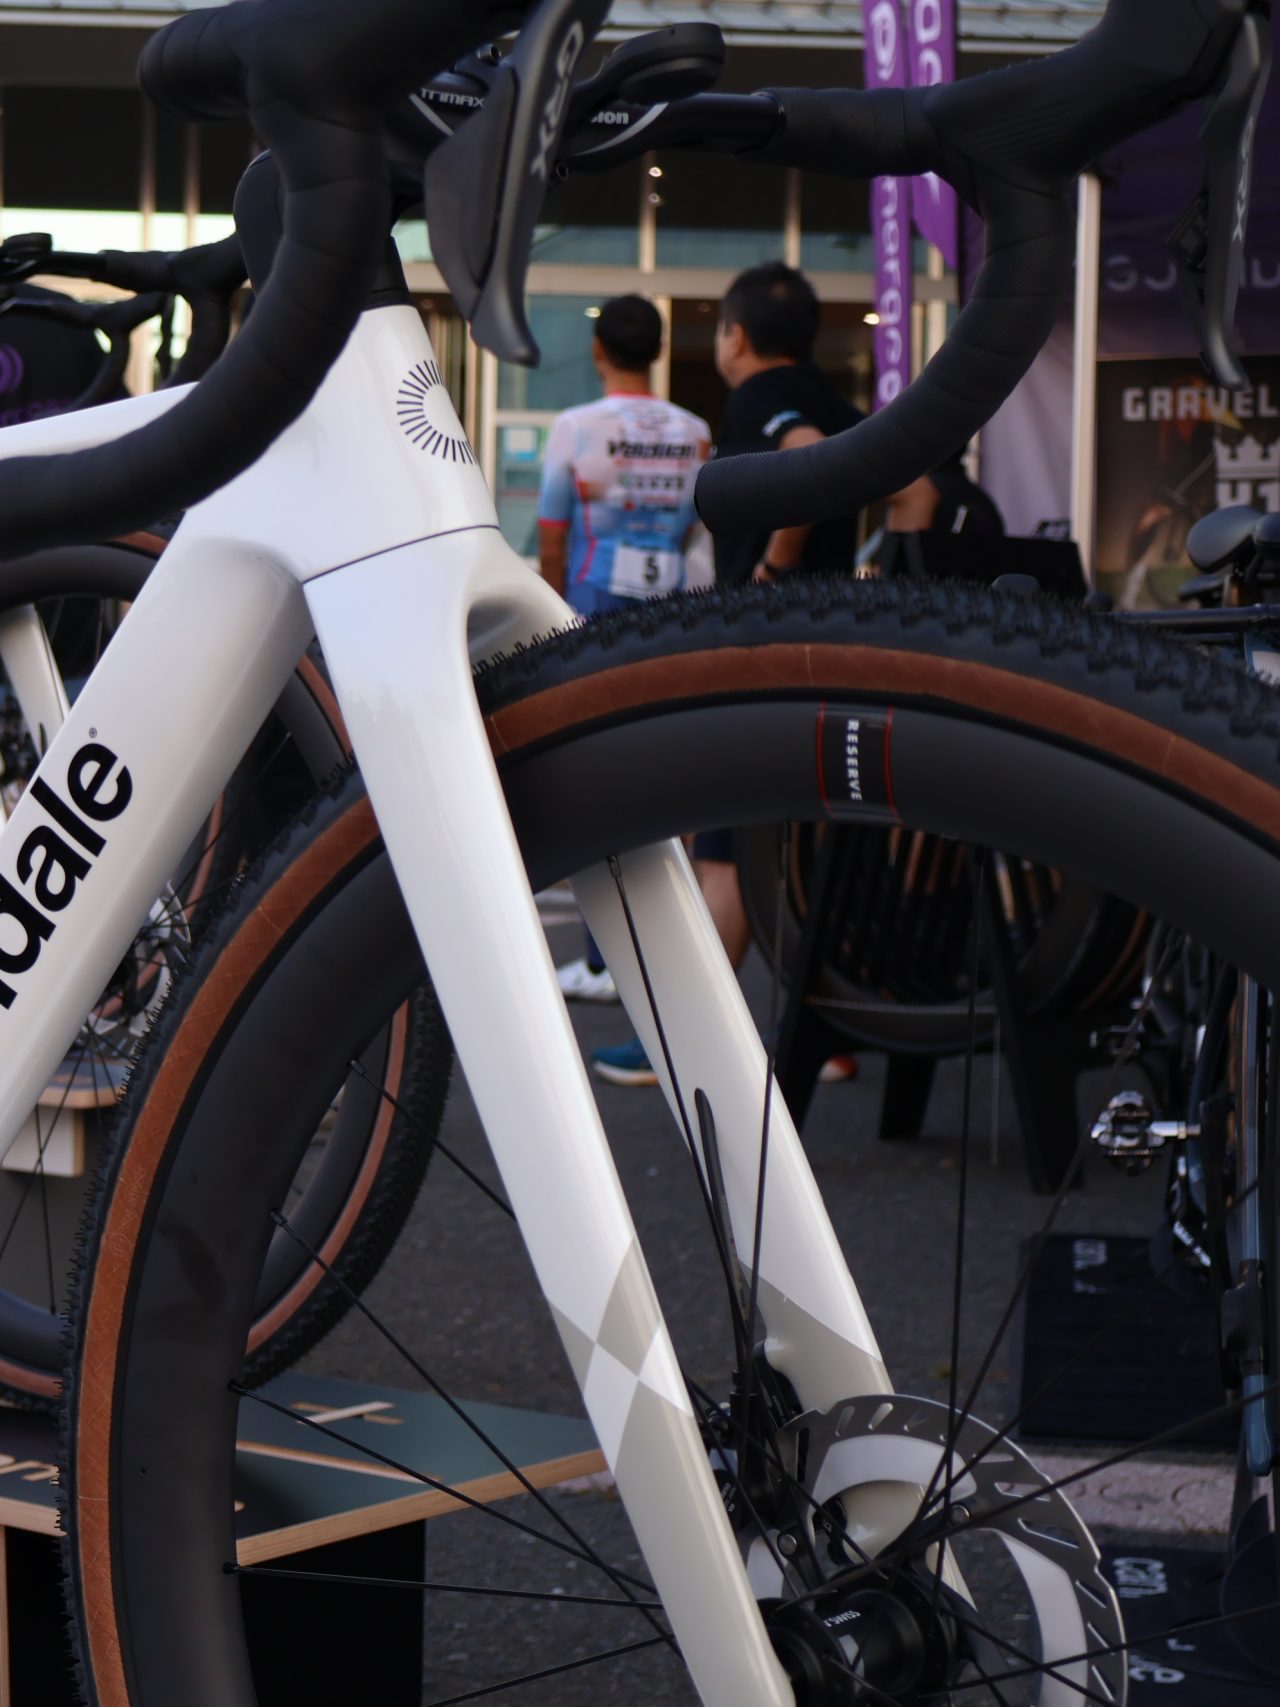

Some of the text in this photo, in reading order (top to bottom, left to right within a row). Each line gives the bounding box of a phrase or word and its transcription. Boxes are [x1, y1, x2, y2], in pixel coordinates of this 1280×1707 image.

[529, 20, 584, 182] GRX
[643, 556, 660, 586] 5
[846, 718, 863, 801] RESERVE
